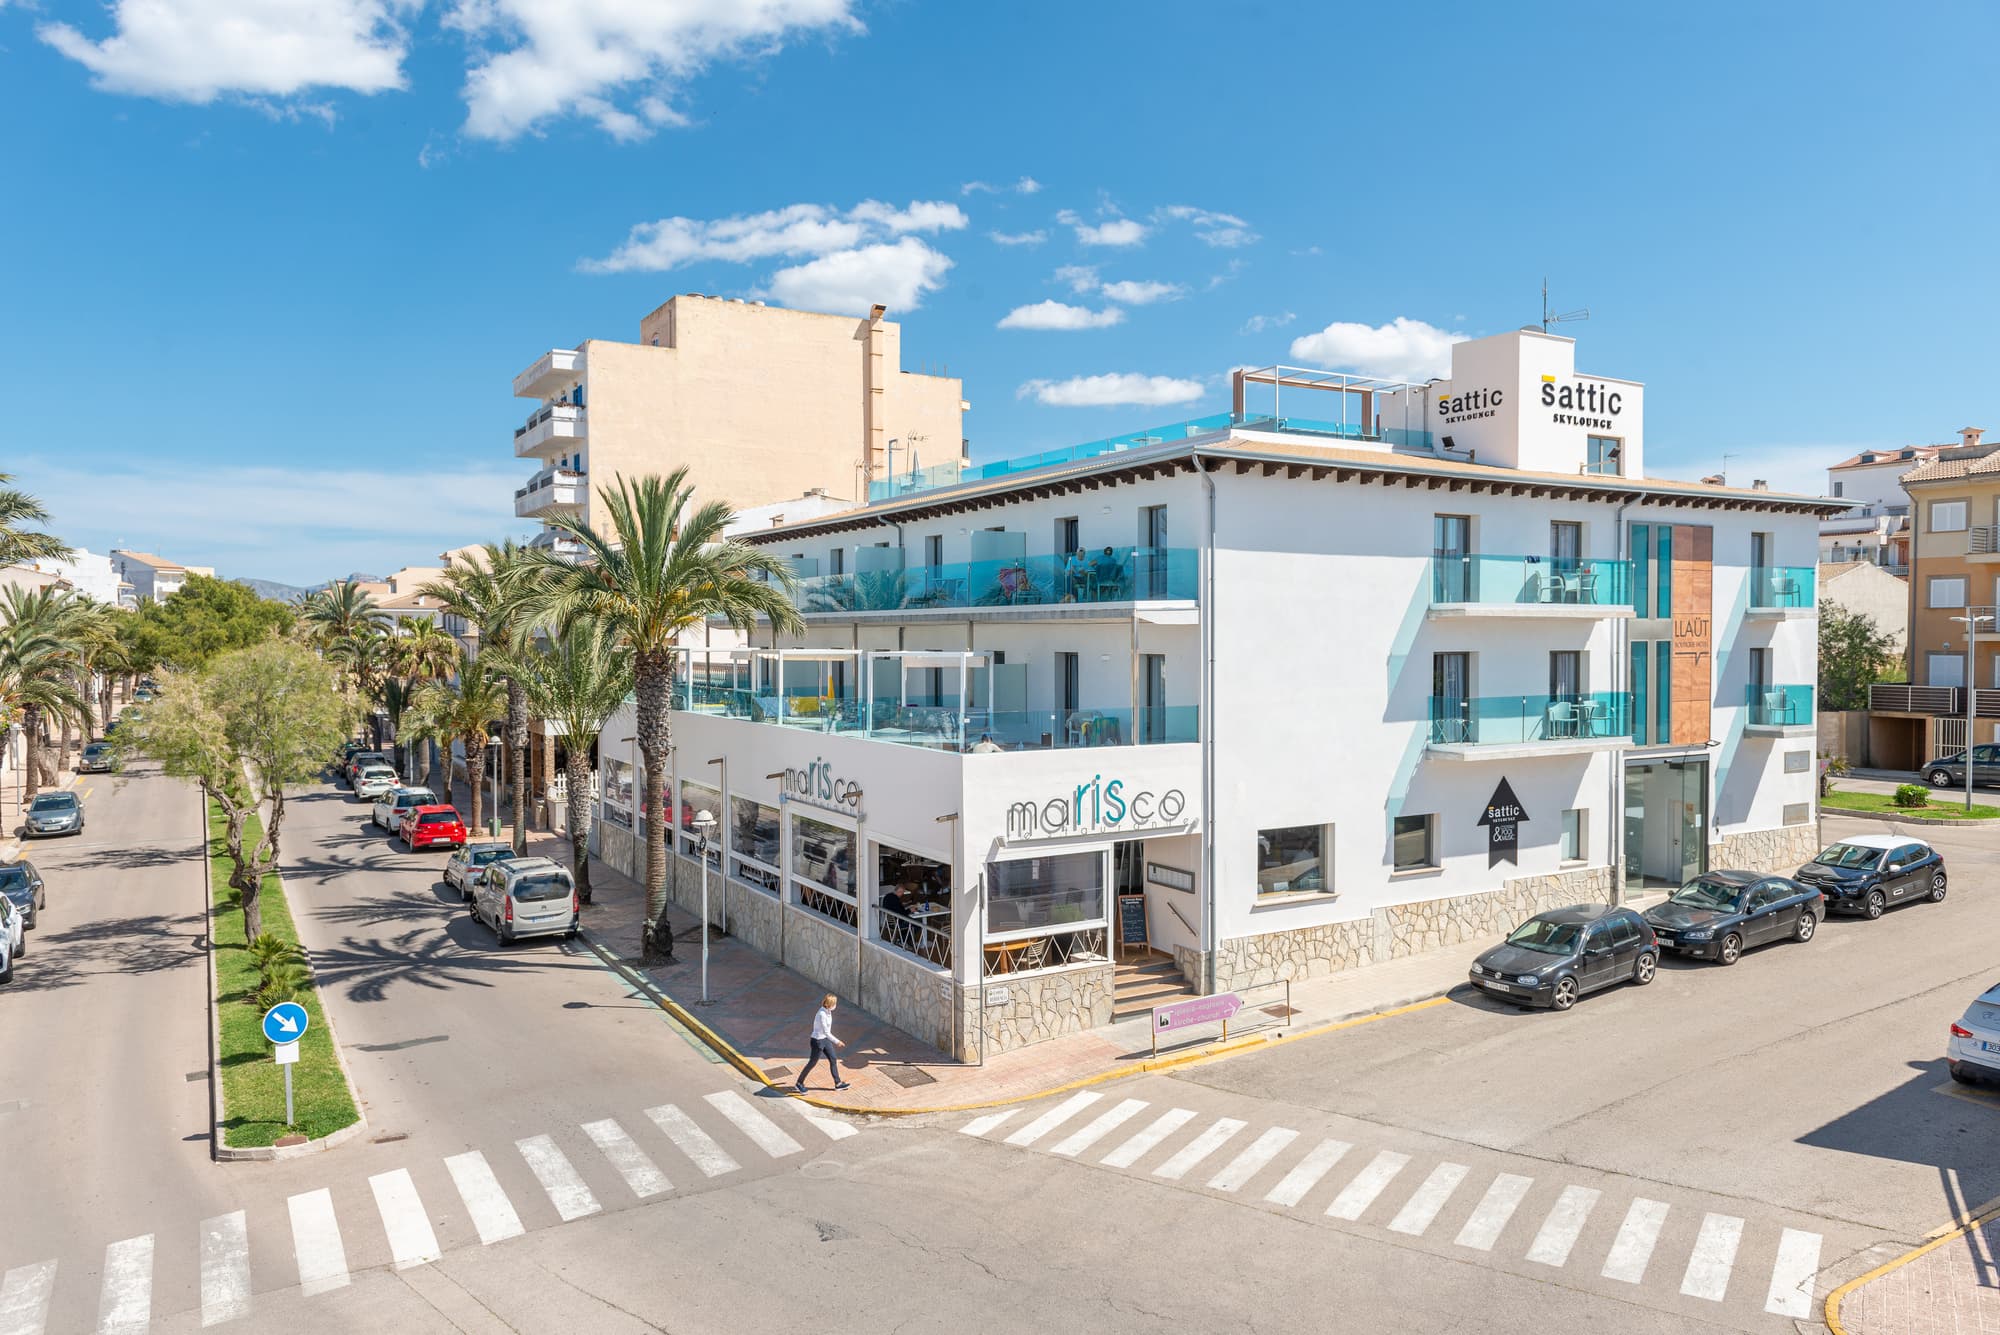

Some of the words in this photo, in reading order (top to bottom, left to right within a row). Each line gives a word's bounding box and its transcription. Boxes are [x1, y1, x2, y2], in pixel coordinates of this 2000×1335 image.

[1439, 388, 1503, 415] sattic
[1542, 381, 1622, 415] sattic
[1445, 410, 1496, 424] SKYLOUNGE
[1553, 413, 1612, 430] SKYLOUNGE
[1675, 617, 1709, 637] LLAÜT
[785, 756, 858, 807] marisco
[1010, 774, 1186, 832] marisco
[1488, 805, 1519, 818] sattic
